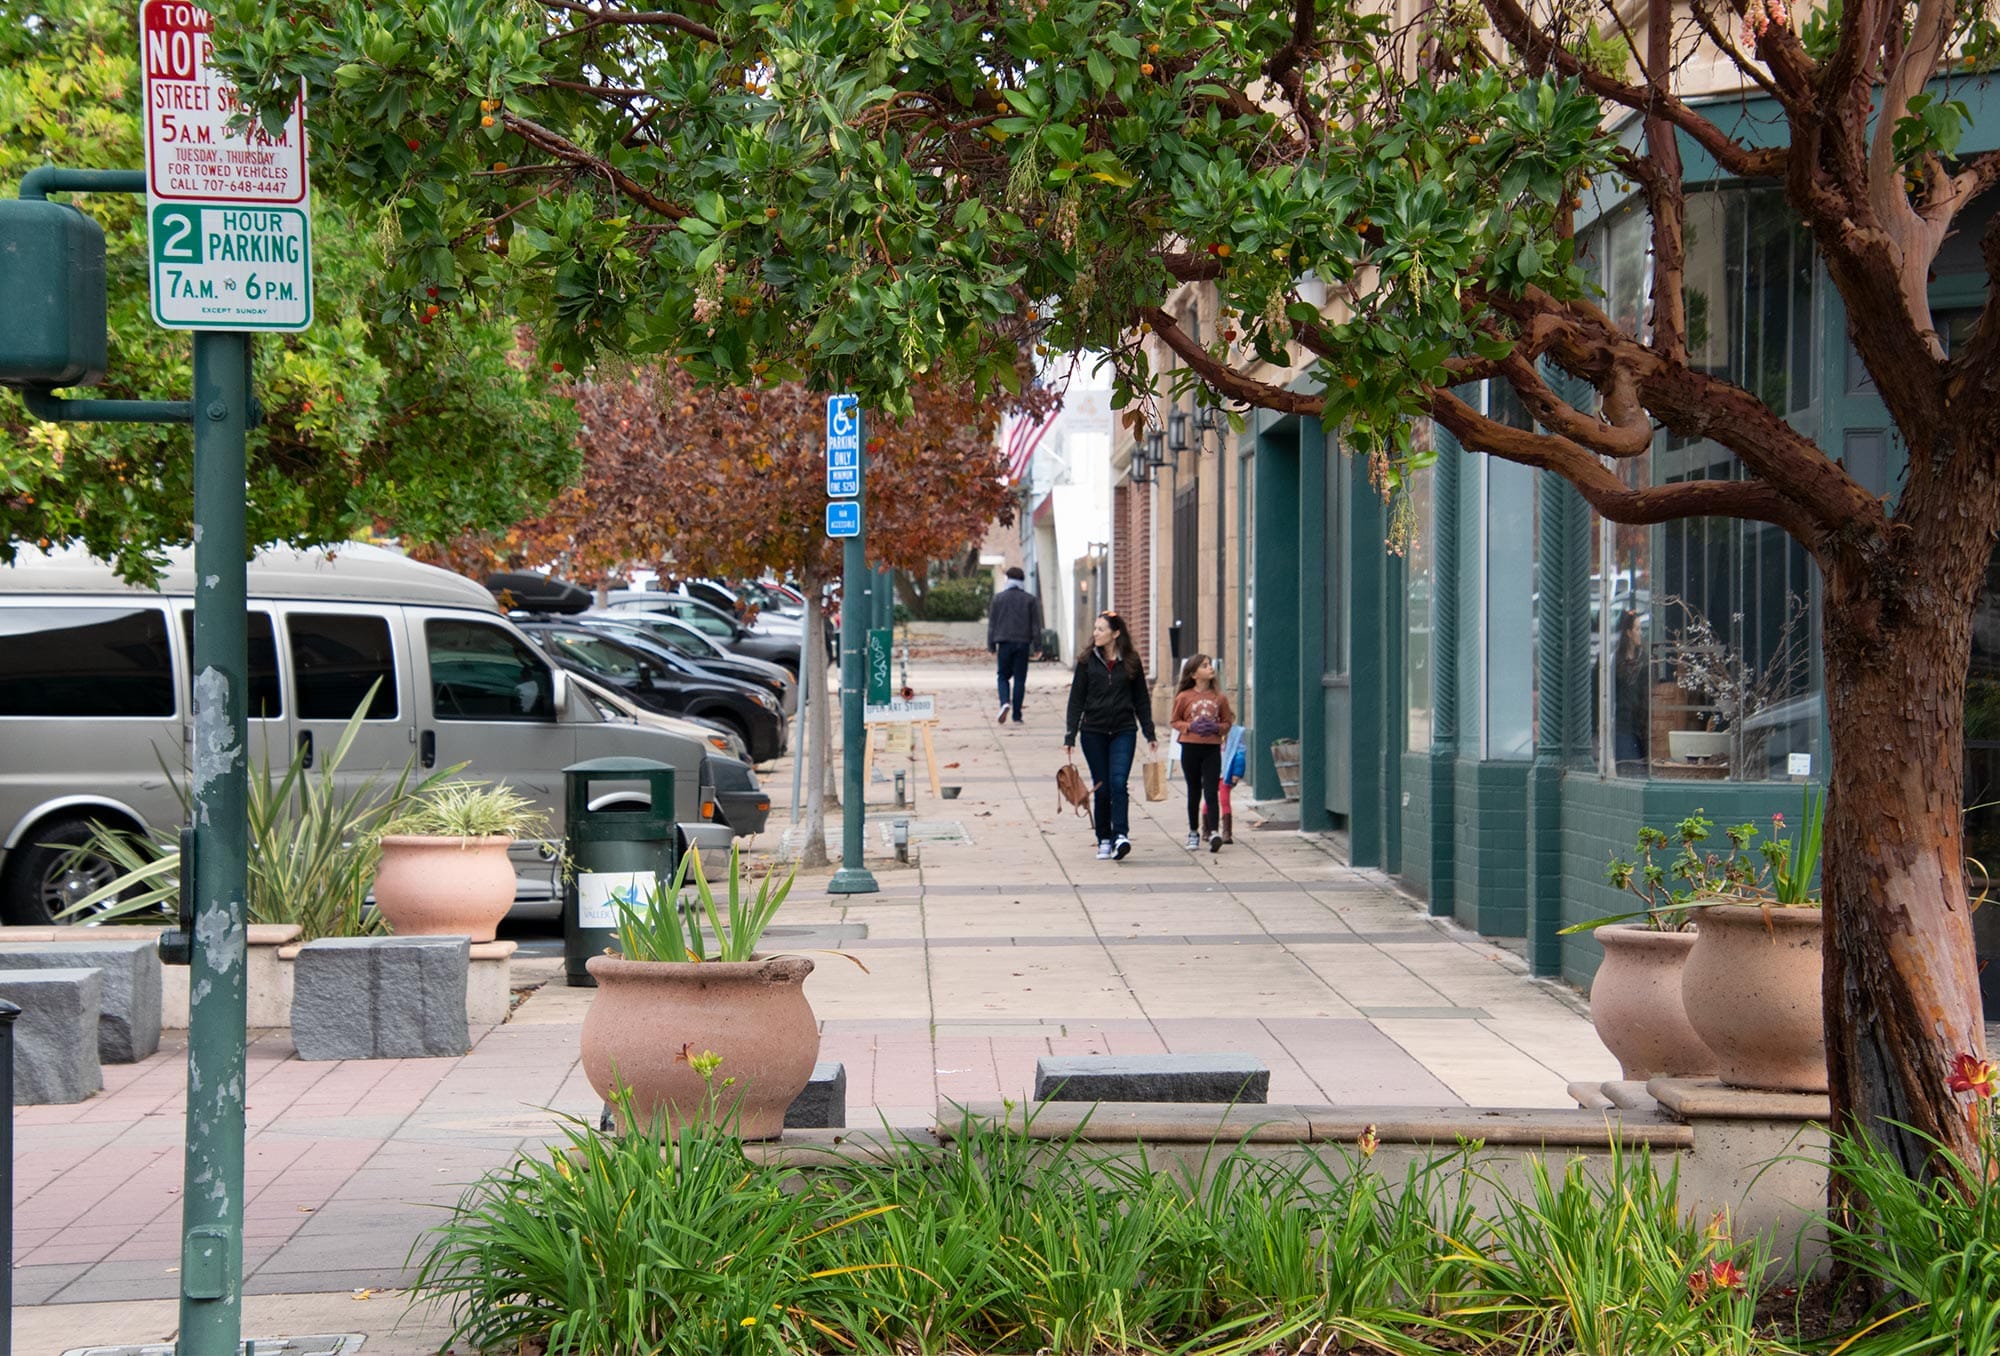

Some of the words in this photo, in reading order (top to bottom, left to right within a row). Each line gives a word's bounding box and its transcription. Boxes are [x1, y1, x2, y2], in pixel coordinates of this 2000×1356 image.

[149, 29, 191, 76] NO
[156, 84, 210, 111] STREET
[226, 150, 275, 165] THURSDAY
[168, 163, 190, 175] FOR
[195, 164, 231, 177] TOWED
[236, 166, 288, 179] VEHICLES
[170, 177, 199, 190] CALL
[203, 179, 286, 193] 707-648-4447
[162, 213, 193, 257] 2
[223, 212, 282, 233] HOUR
[209, 233, 299, 264] PARKING
[830, 435, 856, 449] PARKING
[834, 451, 851, 466] ONLY
